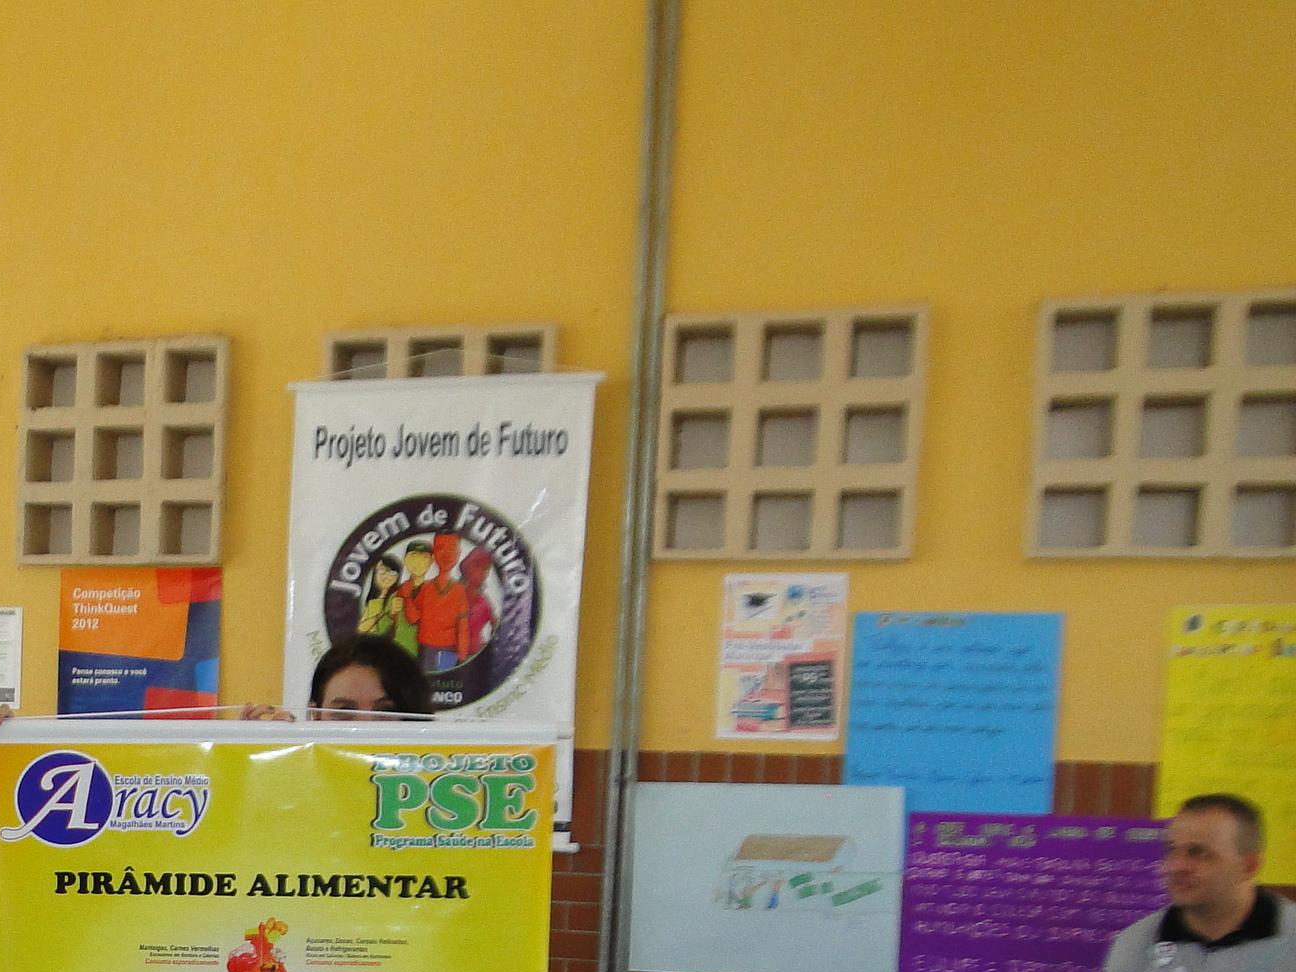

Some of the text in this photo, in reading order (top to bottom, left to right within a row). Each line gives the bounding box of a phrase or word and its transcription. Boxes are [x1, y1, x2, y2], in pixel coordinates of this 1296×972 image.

[313, 420, 569, 468] Projeto Jovem de Futuro
[330, 502, 530, 597] Jovem de Futuro
[72, 587, 141, 600] Competição
[72, 603, 138, 615] ThinkQuest
[71, 618, 99, 630] 2012
[373, 754, 536, 772] PROJETO
[114, 776, 209, 785] Escola de Ensino Médio
[0, 761, 209, 840] Aracy
[373, 773, 537, 830] PSE
[110, 820, 186, 829] Magalhães Martins
[375, 834, 433, 849] Programa
[477, 837, 492, 848] na
[497, 834, 534, 848] Escola
[55, 866, 470, 900] PIRÂMIDE ALIMENTAR
